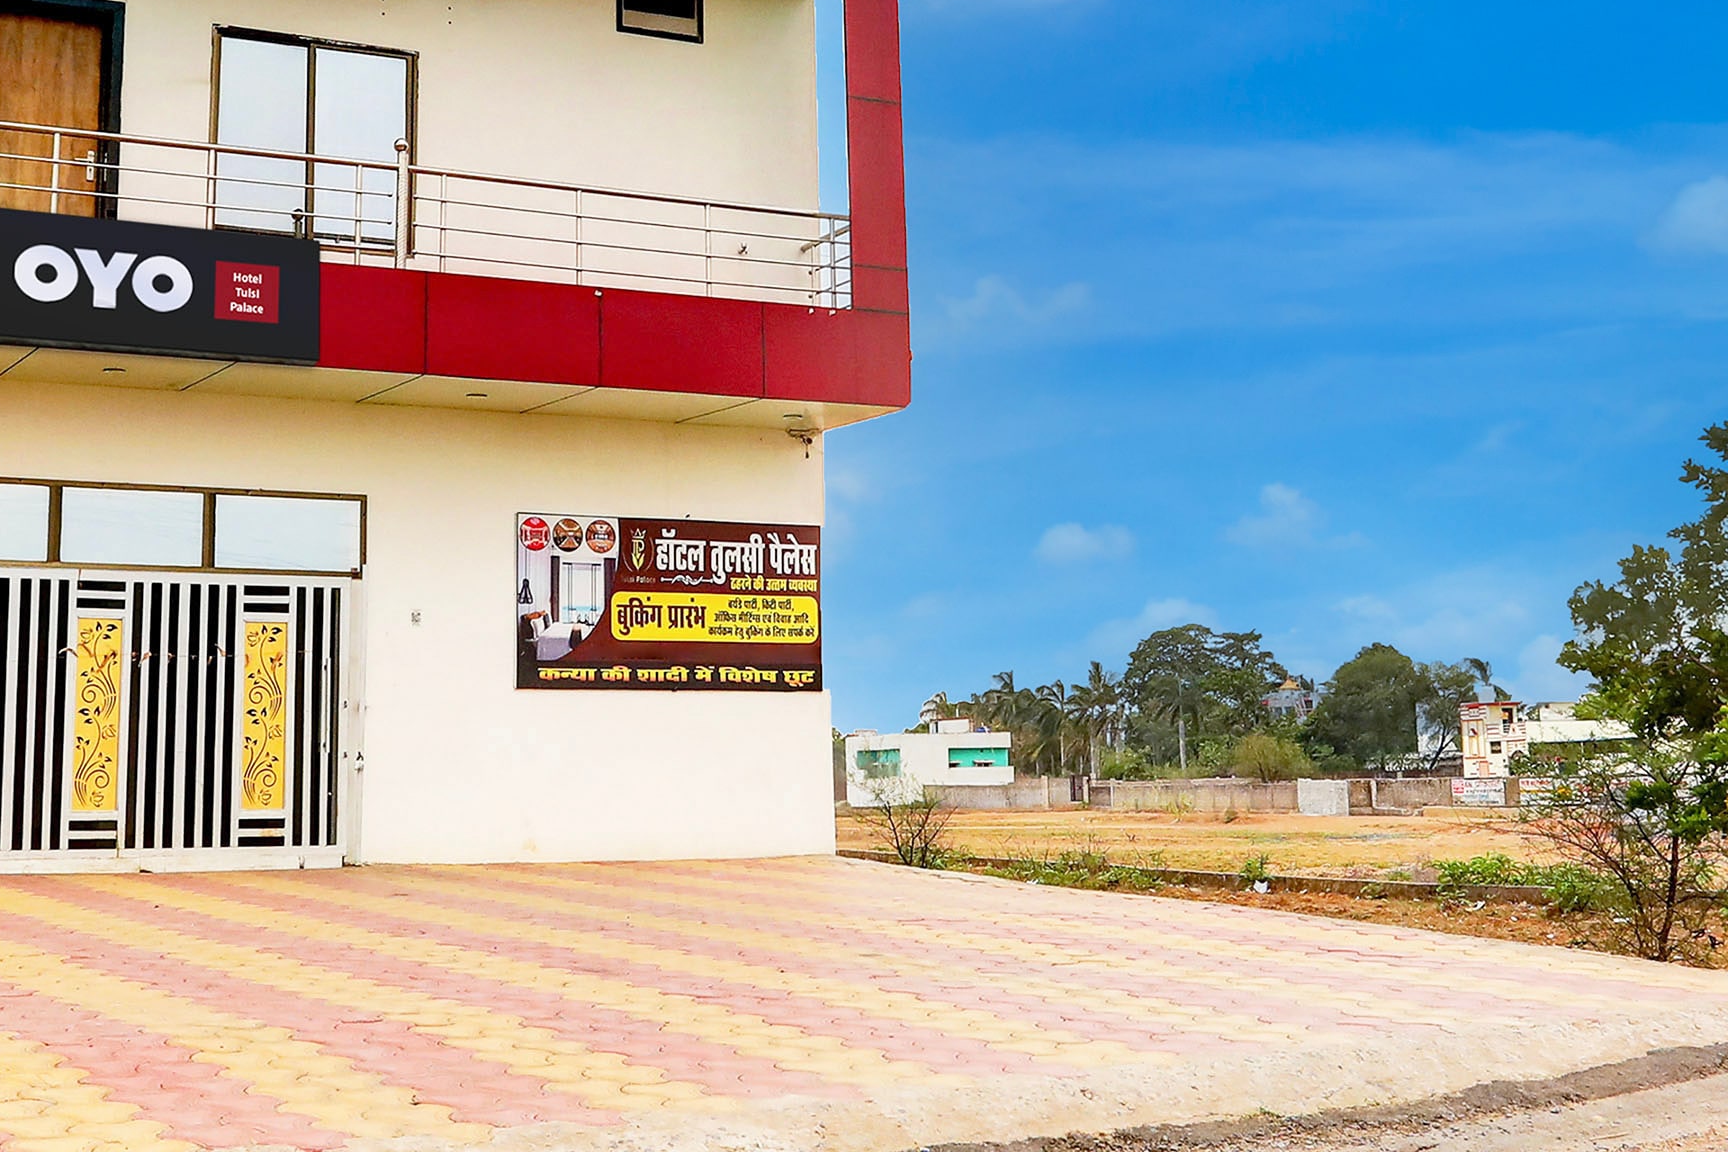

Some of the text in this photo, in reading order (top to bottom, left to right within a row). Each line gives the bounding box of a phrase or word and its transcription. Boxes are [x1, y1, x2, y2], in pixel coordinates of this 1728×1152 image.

[13, 243, 194, 313] OYO
[233, 272, 263, 284] Hotel
[235, 287, 260, 299] Tulsi
[230, 301, 264, 314] Palace
[709, 533, 765, 585] तुलसी
[767, 532, 818, 576] पैलेस
[752, 575, 765, 591] की
[616, 596, 707, 635] बुकिंग प्रारंभ
[537, 665, 816, 688] कन्या की शादी में विशेष छूट
